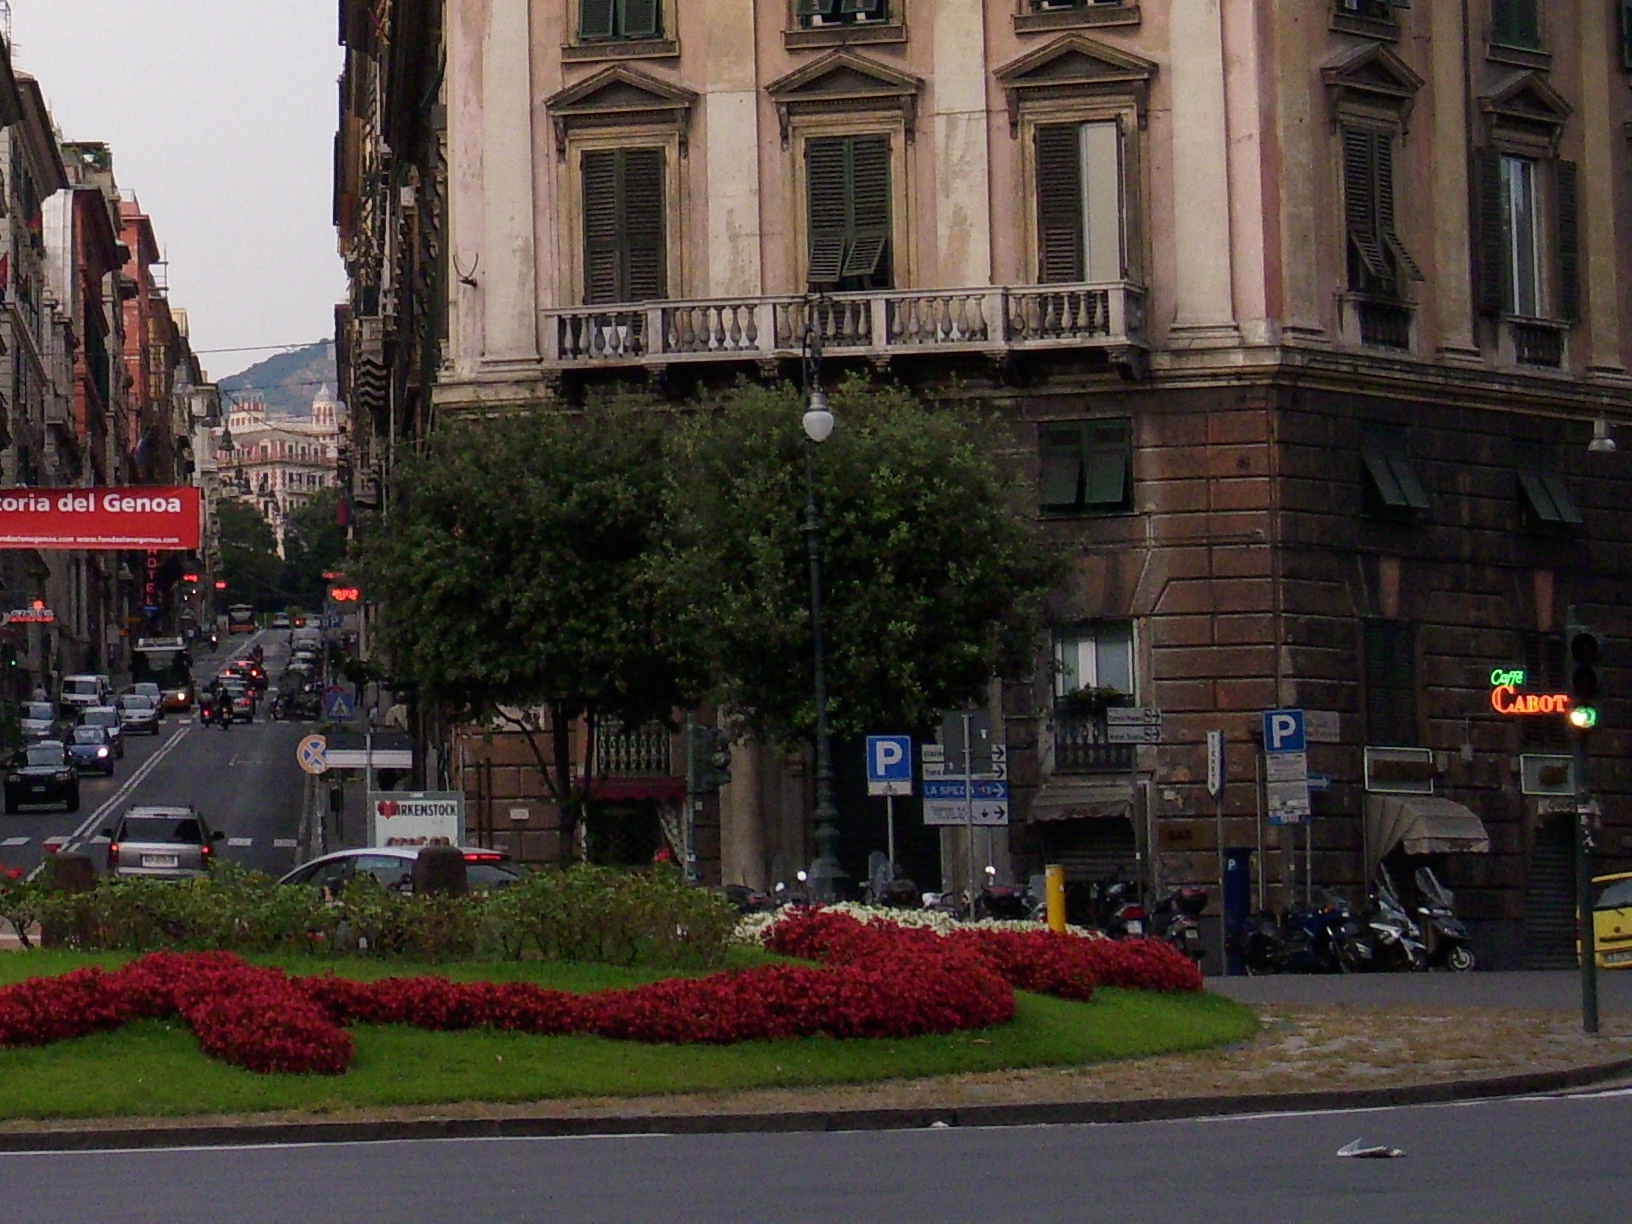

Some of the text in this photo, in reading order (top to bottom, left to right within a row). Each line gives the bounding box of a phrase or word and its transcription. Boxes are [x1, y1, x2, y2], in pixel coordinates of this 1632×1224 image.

[57, 492, 95, 512] del
[102, 493, 181, 513] Genoa
[1271, 714, 1296, 749] P
[875, 740, 903, 776] P
[940, 786, 976, 795] SPEZA
